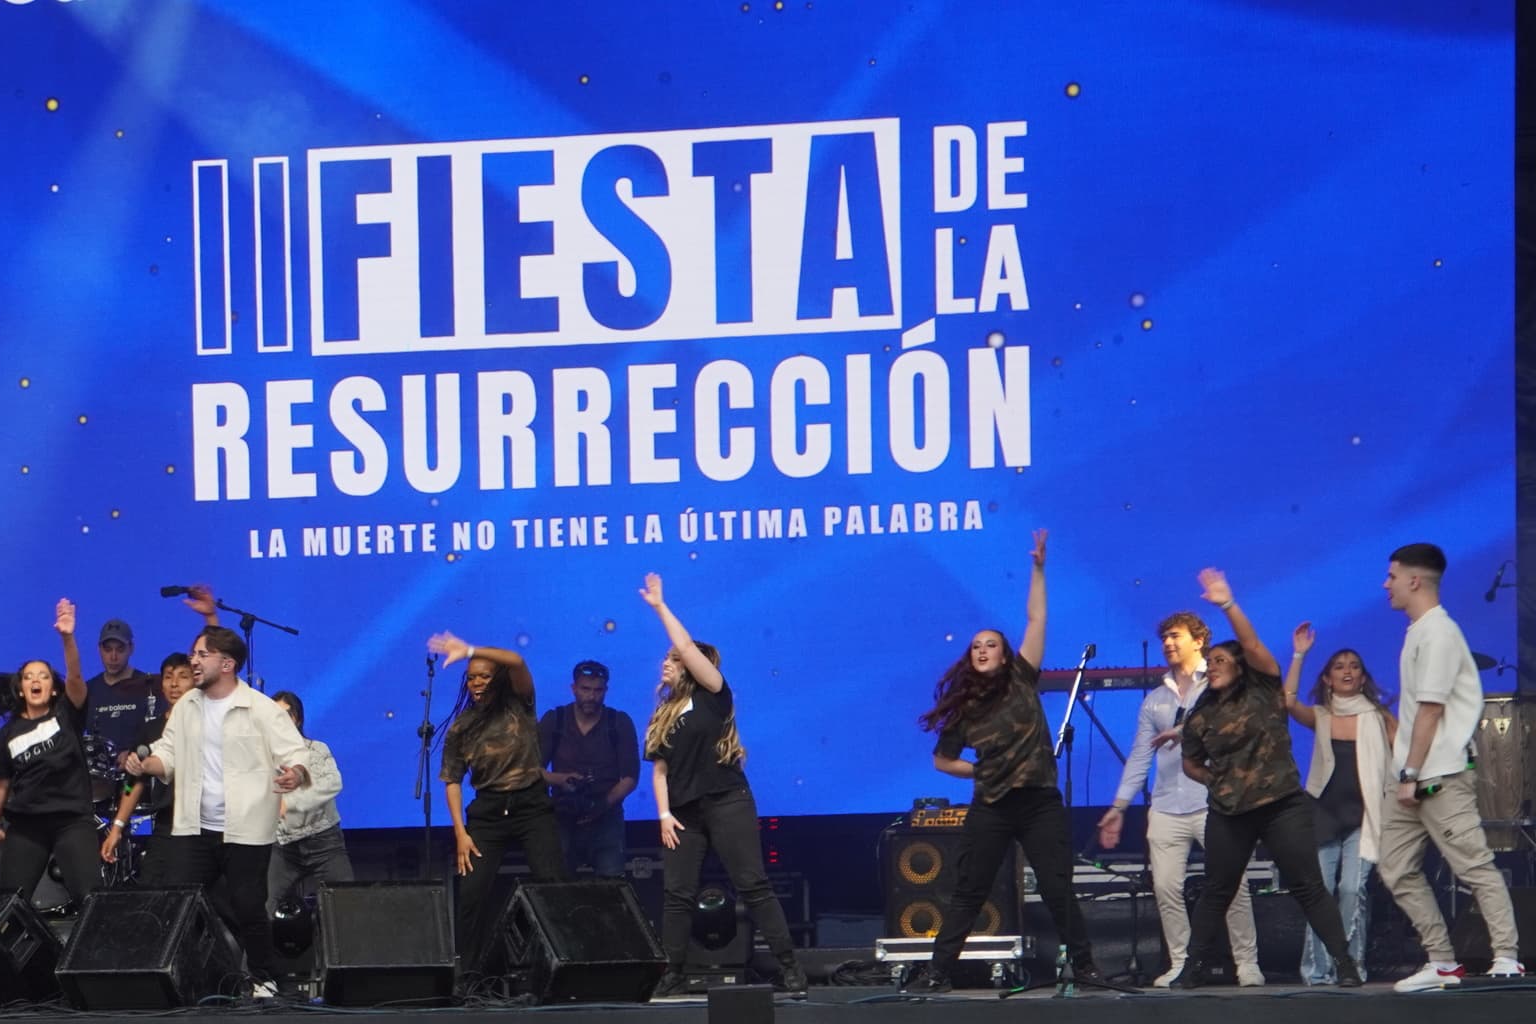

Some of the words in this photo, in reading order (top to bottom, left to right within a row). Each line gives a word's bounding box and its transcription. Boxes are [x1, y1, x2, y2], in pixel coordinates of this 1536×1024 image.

[933, 120, 1028, 213] DE
[312, 124, 901, 352] FIESTA
[934, 223, 1030, 315] LA
[191, 318, 1031, 502] RESURRECCIÓN
[249, 528, 287, 559] LA
[302, 522, 437, 557] MUERTE
[452, 520, 495, 551] NO
[511, 515, 609, 549] TIENE
[625, 513, 663, 545] LA
[679, 506, 808, 543] ÚLTIMA
[823, 500, 983, 537] PALABRA
